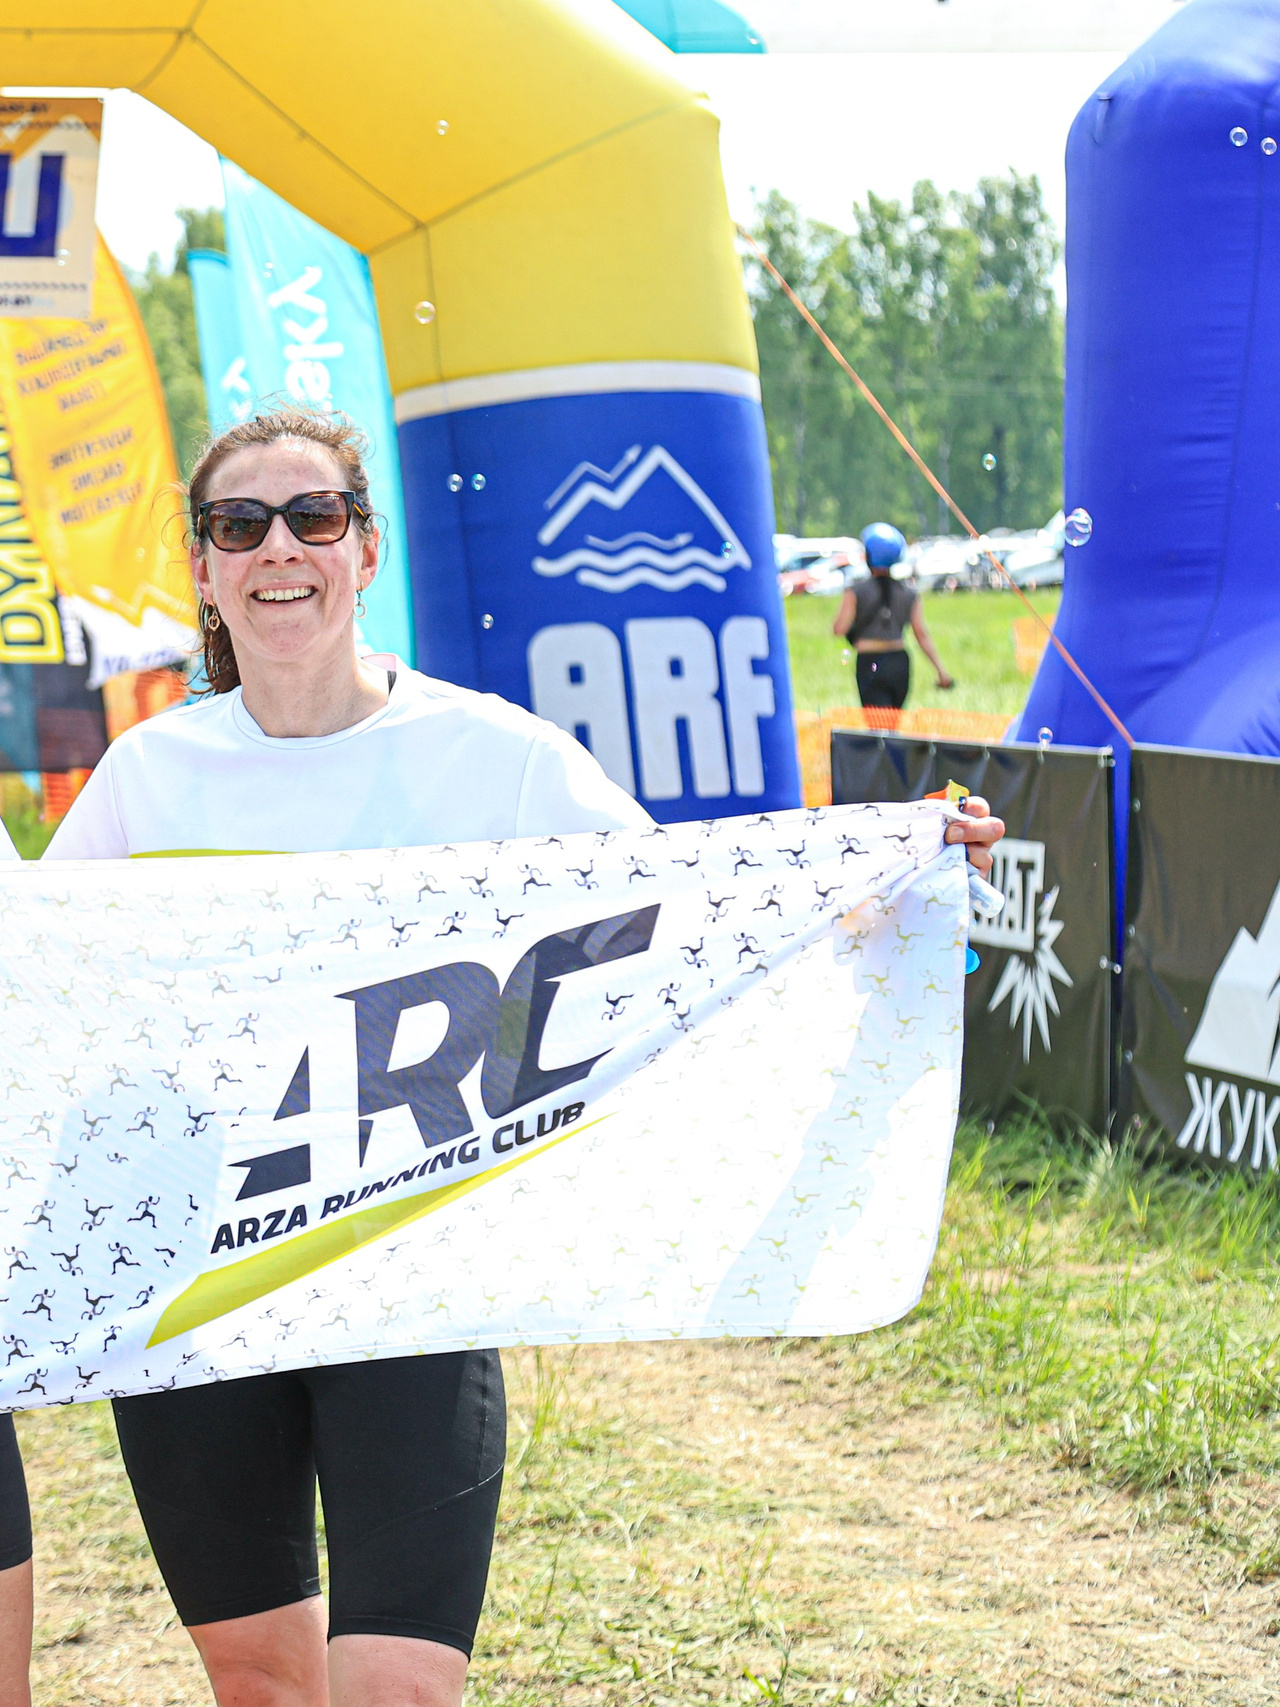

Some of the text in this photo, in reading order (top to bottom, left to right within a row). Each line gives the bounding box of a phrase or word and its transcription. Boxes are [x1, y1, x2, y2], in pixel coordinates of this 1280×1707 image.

[527, 616, 774, 800] ARF
[227, 903, 661, 1202] ARC
[210, 1101, 586, 1254] ARZA RUNNING CLUB
